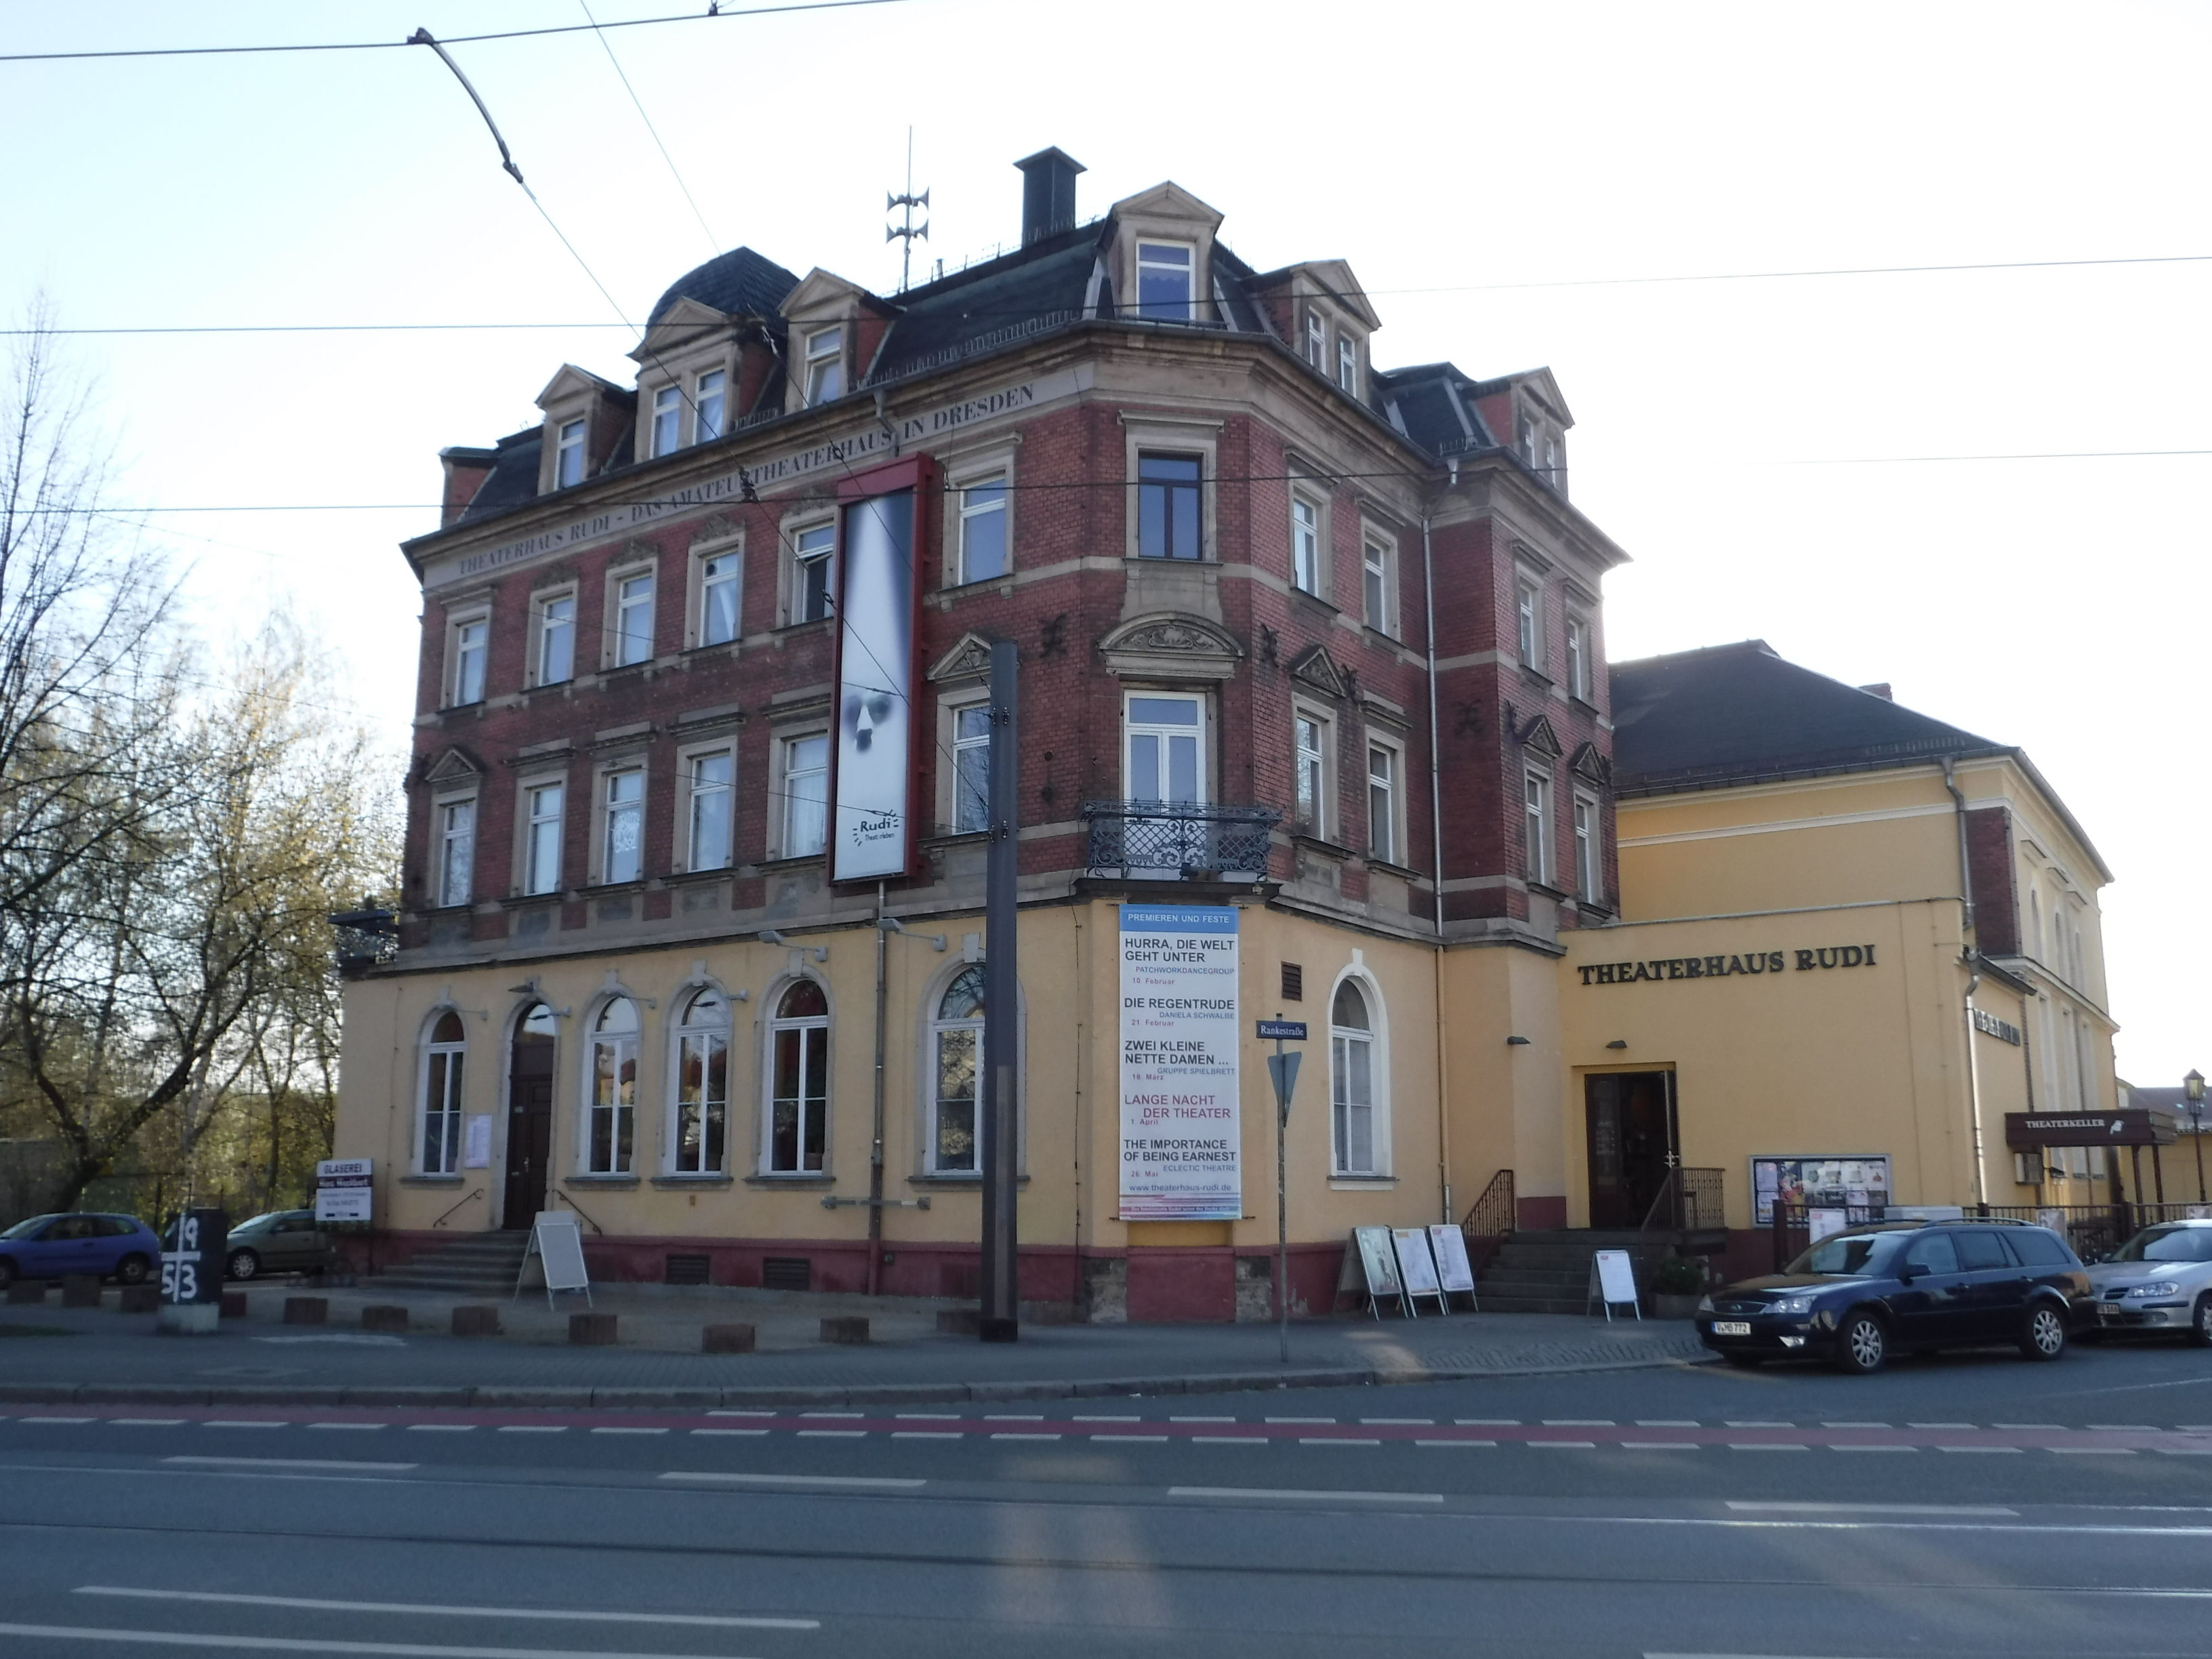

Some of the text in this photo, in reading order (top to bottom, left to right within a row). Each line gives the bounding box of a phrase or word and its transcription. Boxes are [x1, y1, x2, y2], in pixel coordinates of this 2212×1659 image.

[459, 529, 563, 575] THEATERHAUS
[571, 515, 609, 541] RUDI
[904, 417, 924, 438] IN
[933, 384, 1033, 430] DRESDEN
[861, 817, 891, 832] Rudi
[1128, 913, 1178, 922] PREMIEREN
[1202, 915, 1230, 923] FESTE
[1125, 938, 1235, 950] HURRA, DIE WELT
[1125, 951, 1206, 962] GEHT UNTER
[1578, 944, 1877, 985] THEATERHAUS RUDI
[1135, 966, 1235, 975] PATCHWORKDANCEGROUP
[1124, 998, 1235, 1010] DIE REGENTRUDE
[1261, 1025, 1304, 1036] Rankestraße
[1125, 1040, 1205, 1051] ZWEI KLEINE
[1125, 1053, 1166, 1064] NETTE
[1170, 1054, 1214, 1065] DAMEN
[1124, 1094, 1215, 1105] LANGE NACHT
[1143, 1108, 1231, 1119] DER THEATER
[2025, 1119, 2105, 1128] THEATERKELLER
[1124, 1139, 1227, 1149] THE IMPORTANCE
[1124, 1151, 1236, 1162] OF BEING EARNEST
